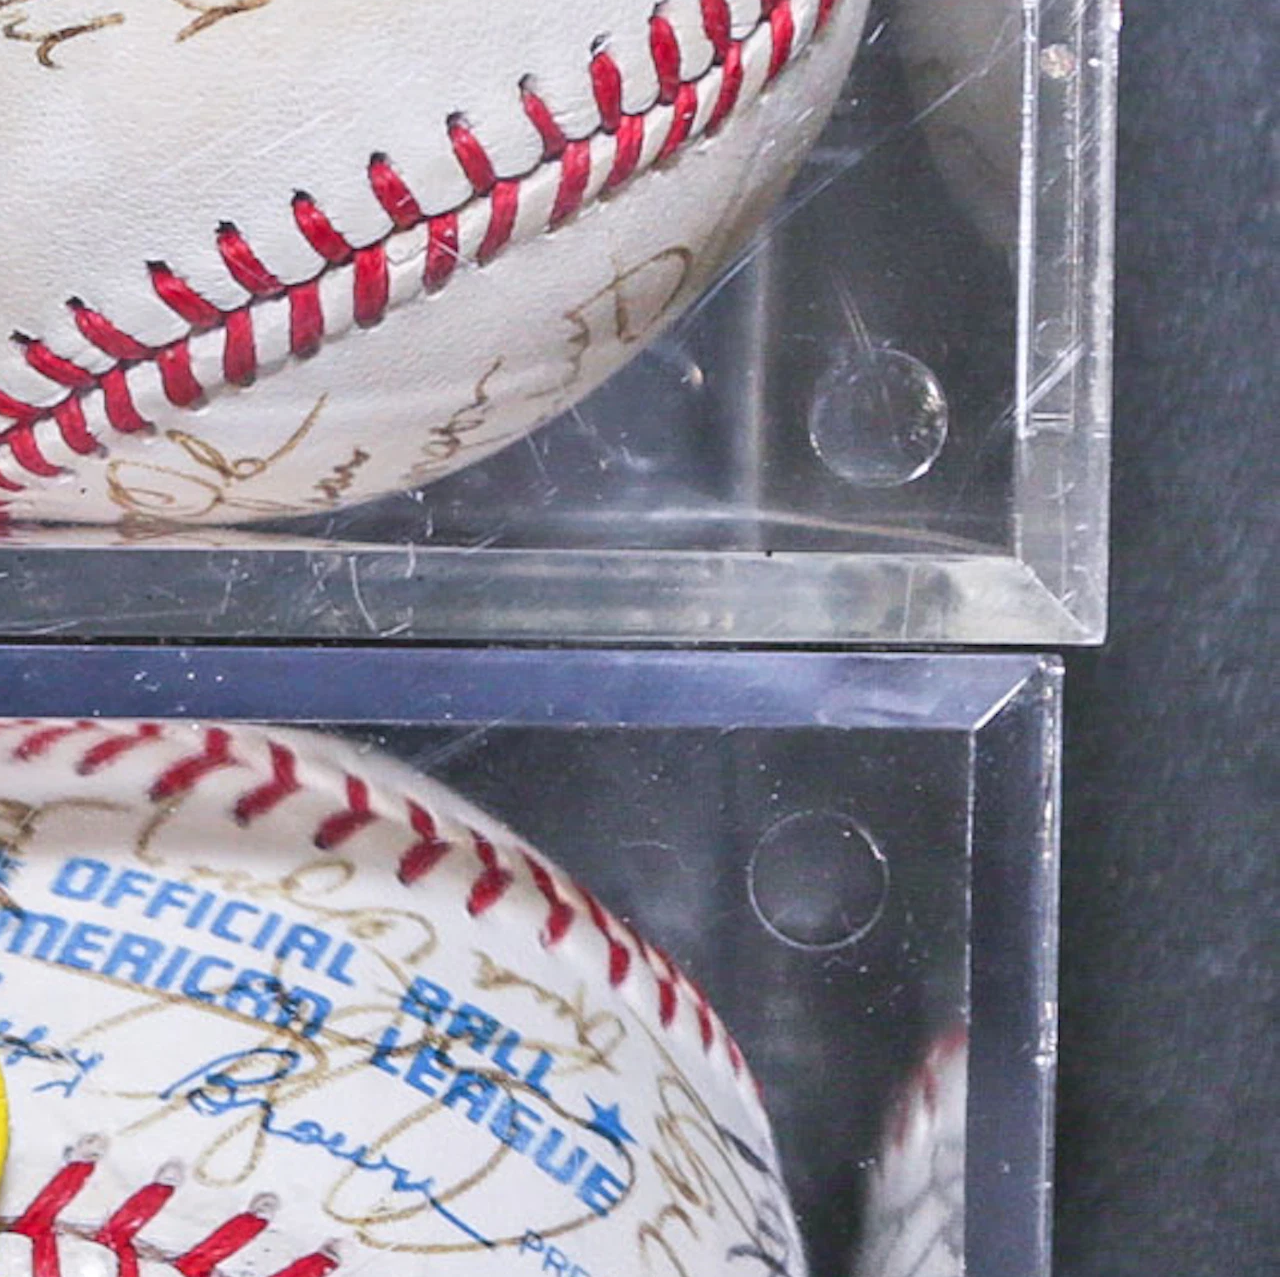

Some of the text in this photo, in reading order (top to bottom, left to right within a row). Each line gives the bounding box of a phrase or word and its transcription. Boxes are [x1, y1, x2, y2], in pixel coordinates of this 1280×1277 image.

[50, 855, 358, 988] OFFICIAL
[398, 974, 556, 1101] BALL
[368, 1024, 628, 1219] LEAGUE
